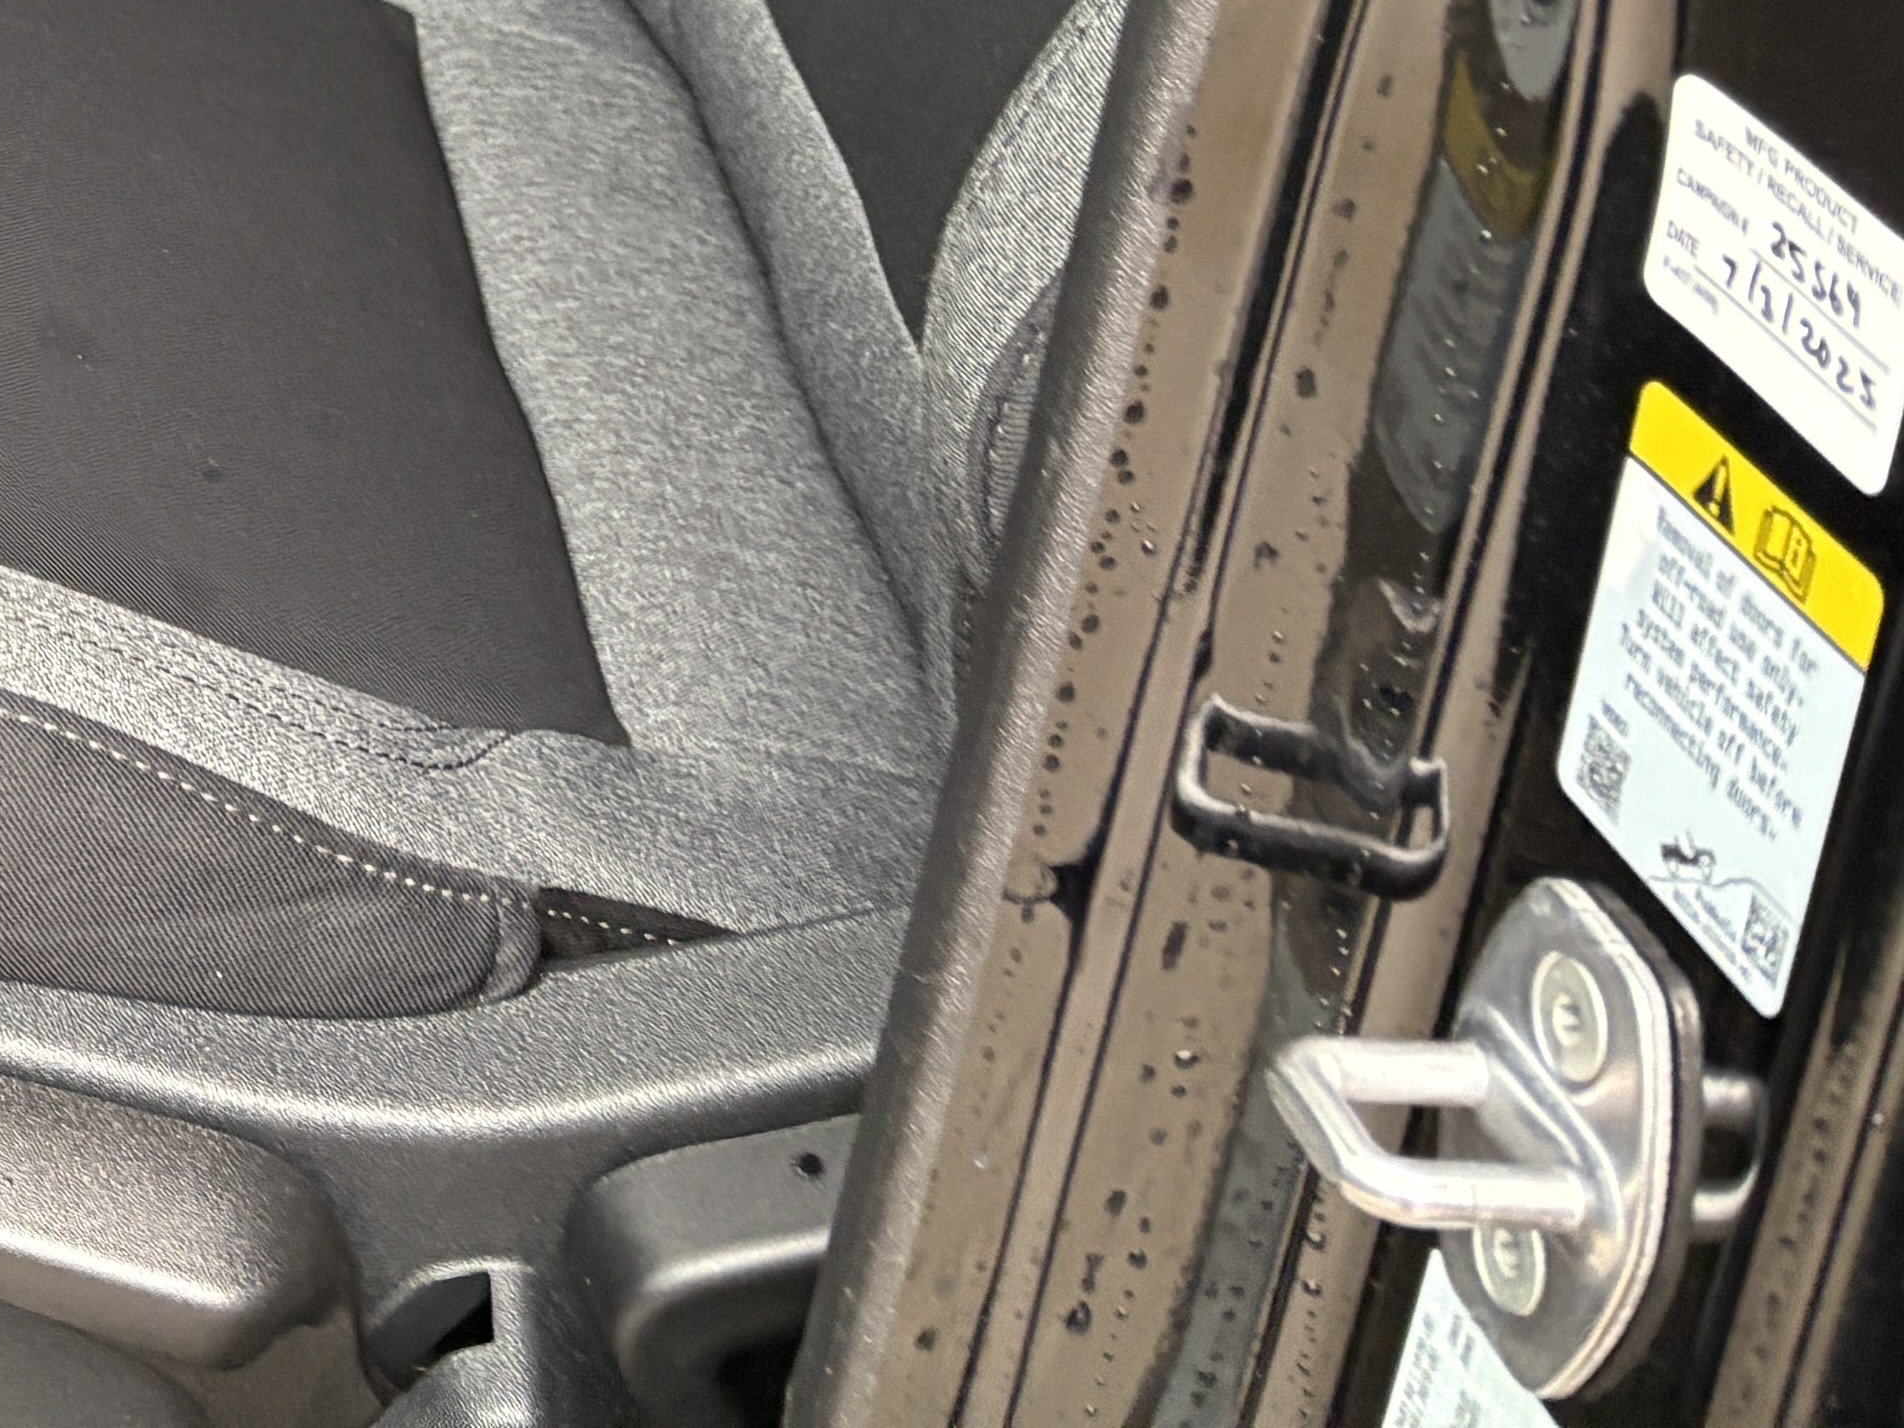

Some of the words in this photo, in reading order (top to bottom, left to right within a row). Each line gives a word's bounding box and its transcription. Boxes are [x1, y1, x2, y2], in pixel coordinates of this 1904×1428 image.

[1694, 118, 1755, 178] SAFETY
[1767, 173, 1826, 244] RECALL
[1836, 233, 1903, 309] SERVICE
[1784, 157, 1858, 235] PRODUCT
[1666, 220, 1700, 258] DATE
